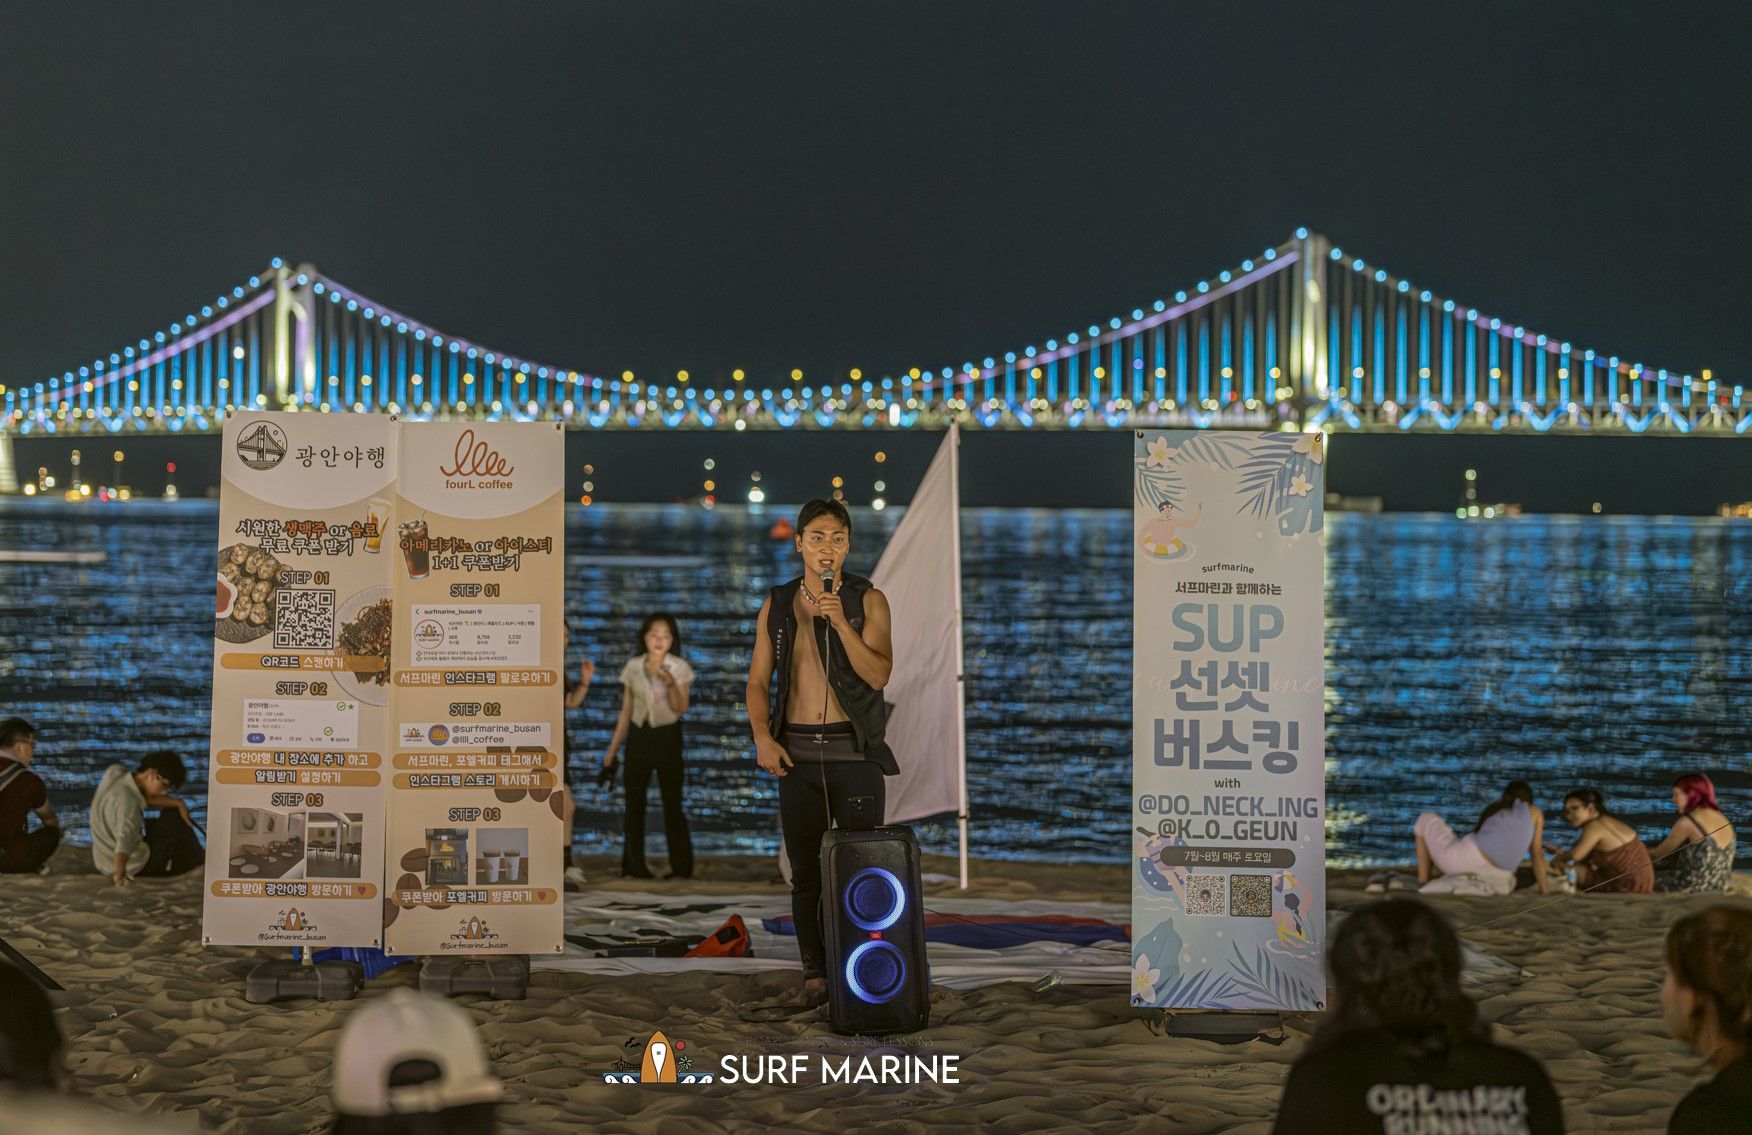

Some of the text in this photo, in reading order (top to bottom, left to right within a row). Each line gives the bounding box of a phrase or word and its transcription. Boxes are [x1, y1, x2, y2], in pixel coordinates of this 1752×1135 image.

[295, 445, 385, 469] 광안야행
[446, 480, 513, 489] fourL coffee
[236, 519, 379, 538] 시원한 생맥주 or 음료
[260, 537, 354, 556] 무료 쿠폰 받기
[400, 536, 553, 554] 아메리카노 or 아이스티
[432, 554, 520, 571] 1+1 쿠폰받기
[1202, 562, 1255, 574] surfmarine
[281, 571, 330, 585] STEP 01
[450, 584, 500, 598] STEP 01
[1175, 581, 1282, 595] 서프마린과 함께하는
[1171, 603, 1285, 653] SUP
[261, 655, 344, 669] QR코드 스캔하기
[400, 671, 550, 685] 서프마린 인스타그램 팔로우하기
[276, 681, 328, 696] STEP 02
[1170, 660, 1270, 712] 선셋
[449, 703, 502, 717] STEP 02
[452, 724, 541, 734] @surfmarine_busan
[1154, 719, 1299, 774] 버스킹
[229, 751, 369, 766] 광안야행 내 장소에 추가 하고
[456, 755, 497, 767] 포엘커피
[501, 755, 542, 767] 태그해서
[255, 769, 341, 784] 알림받기 설정하기
[409, 774, 540, 788] 인스타그램 스토리 게시하기
[1214, 778, 1241, 789] with
[271, 792, 324, 807] STEP 03
[1138, 794, 1319, 818] @DO_NECK_ING
[449, 807, 502, 821] STEP 03
[1184, 851, 1272, 864] 7월~8월 매주 토요일
[220, 881, 352, 897] 쿠폰받아 광안야행 방문하기
[401, 890, 532, 905] 쿠폰받아 포엘커피 방문하기
